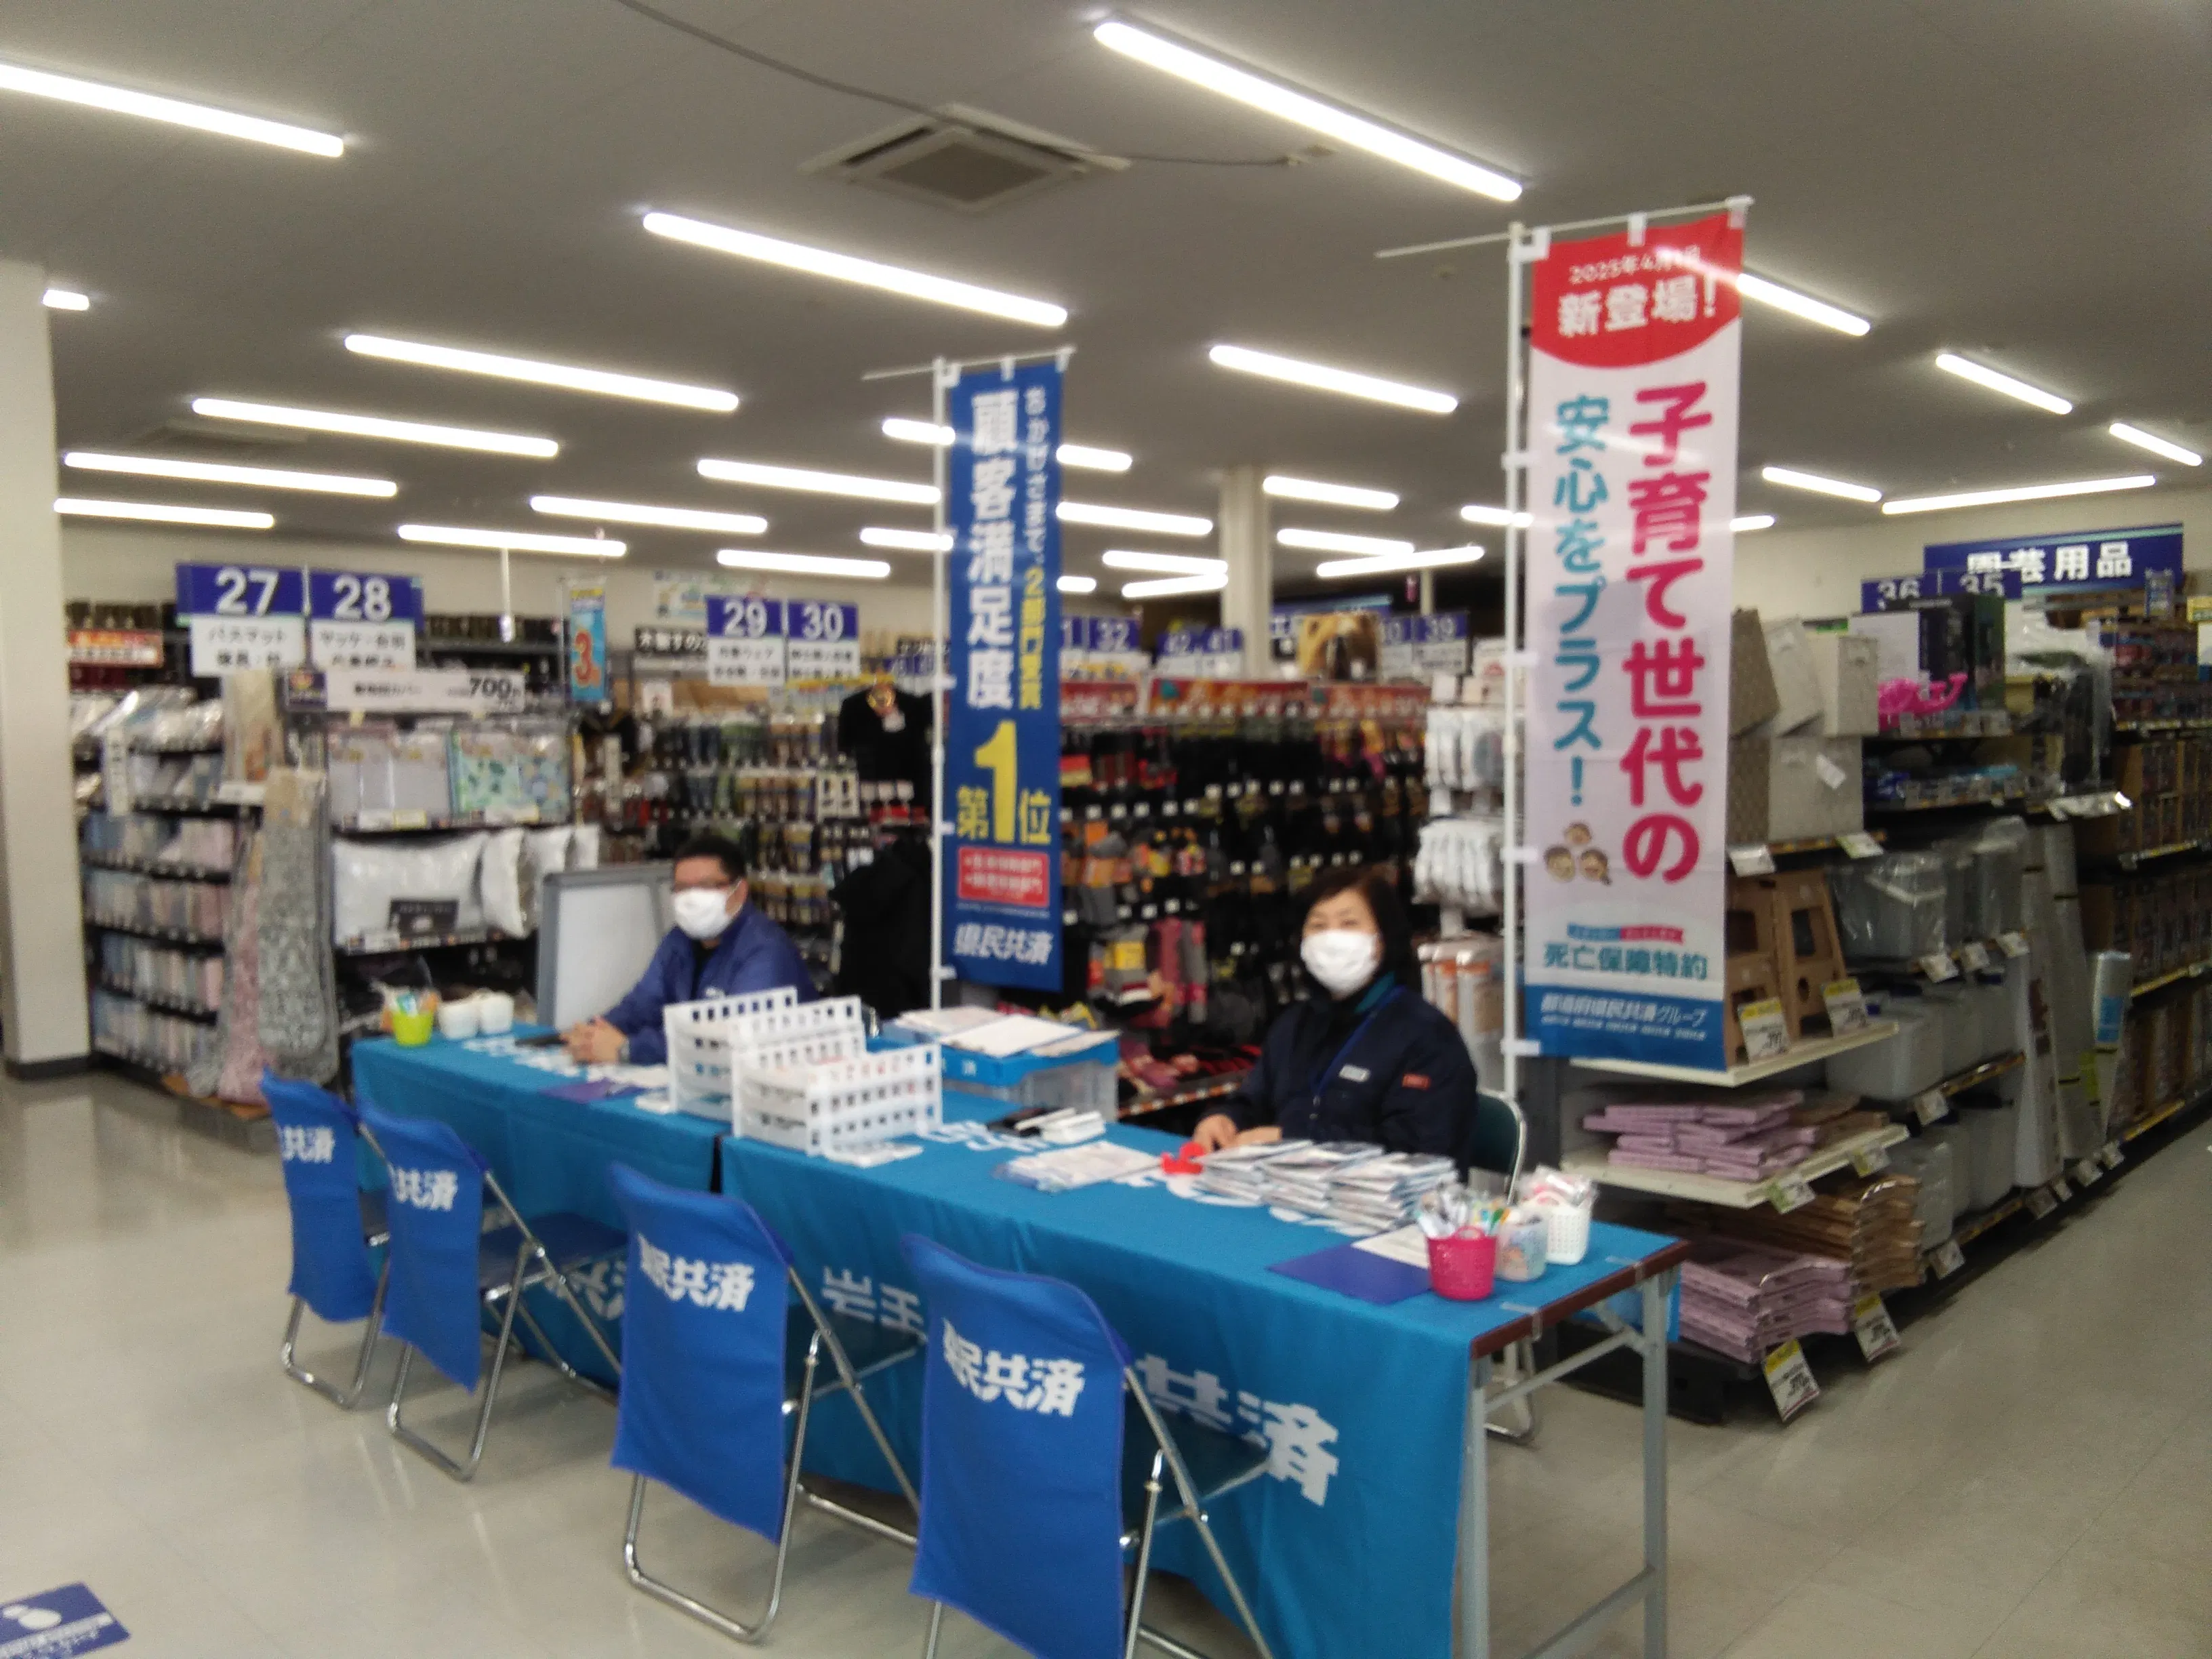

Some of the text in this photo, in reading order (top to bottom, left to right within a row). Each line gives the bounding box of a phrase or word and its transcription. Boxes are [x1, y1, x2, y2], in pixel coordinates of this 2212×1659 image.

[1558, 271, 1716, 338] 新登場！
[967, 389, 1019, 710] 顧客満足度
[215, 567, 279, 617] 27
[332, 575, 392, 620] 28
[1553, 394, 1610, 806] 安心をプラス！
[722, 600, 768, 638] 29
[802, 601, 844, 642] 30
[1096, 620, 1128, 651] 32
[1618, 381, 1713, 883] 子育て世代の
[956, 720, 1052, 844] 第1位
[1544, 941, 1708, 981] 死亡保障特約
[276, 1124, 335, 1164] 共済
[388, 1161, 459, 1212] 共済
